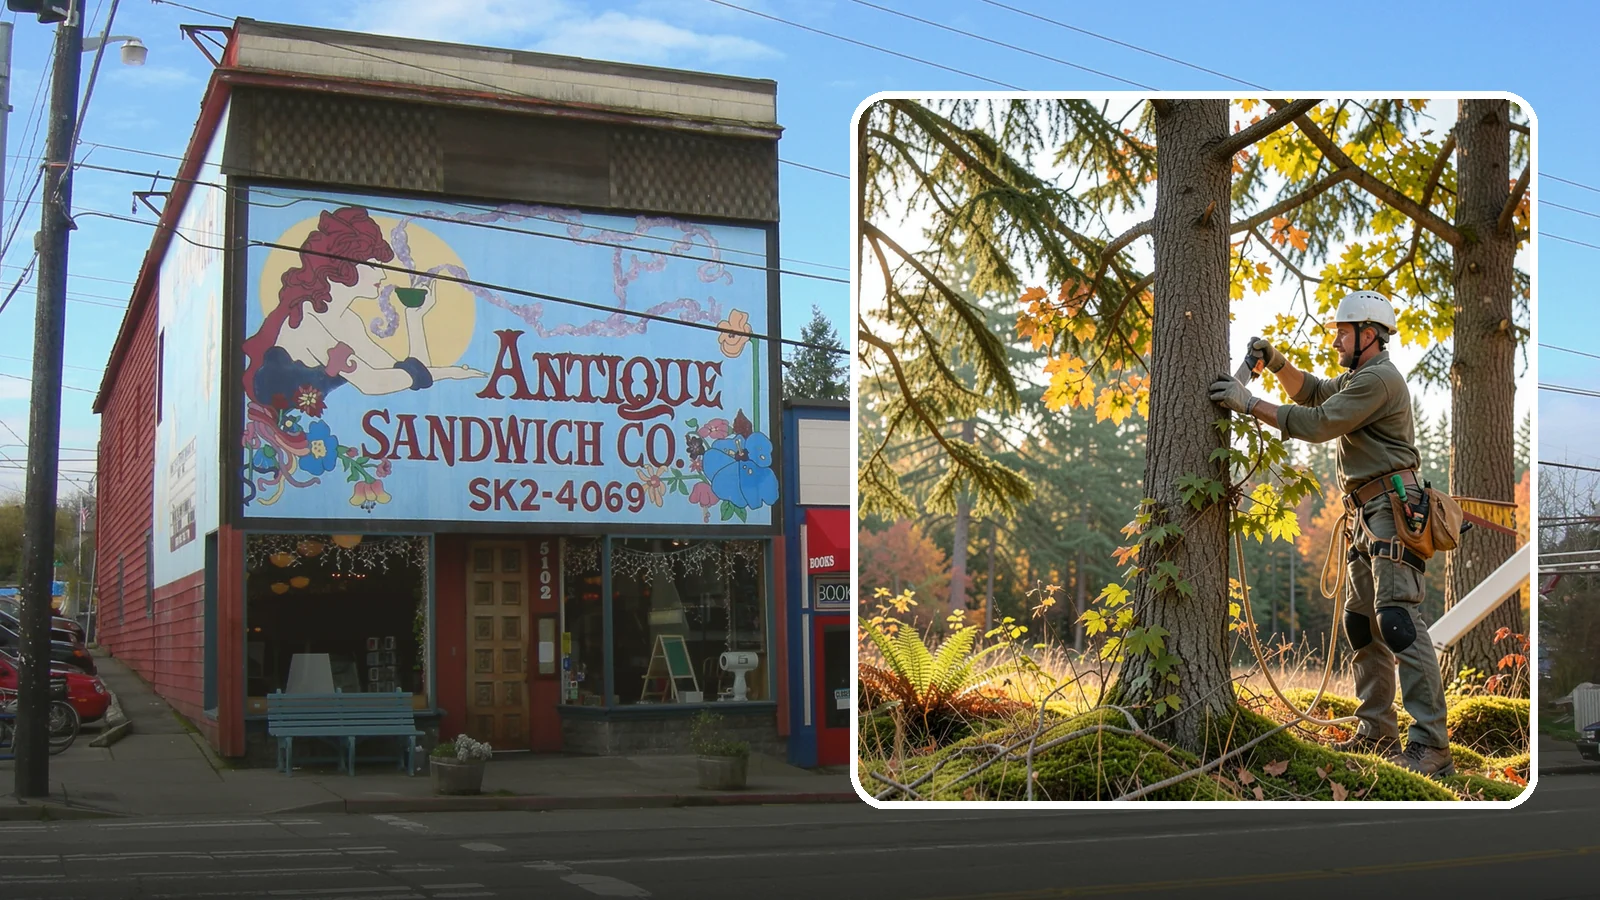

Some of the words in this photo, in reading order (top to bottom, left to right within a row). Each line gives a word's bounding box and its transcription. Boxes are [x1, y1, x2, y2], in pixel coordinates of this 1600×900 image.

[475, 329, 724, 422] ANTIQUE
[361, 408, 604, 467] SANDWICH
[617, 421, 685, 469] CO.
[468, 477, 645, 513] SK2-4069
[540, 541, 552, 600] 5102
[809, 555, 835, 569] BOOKS
